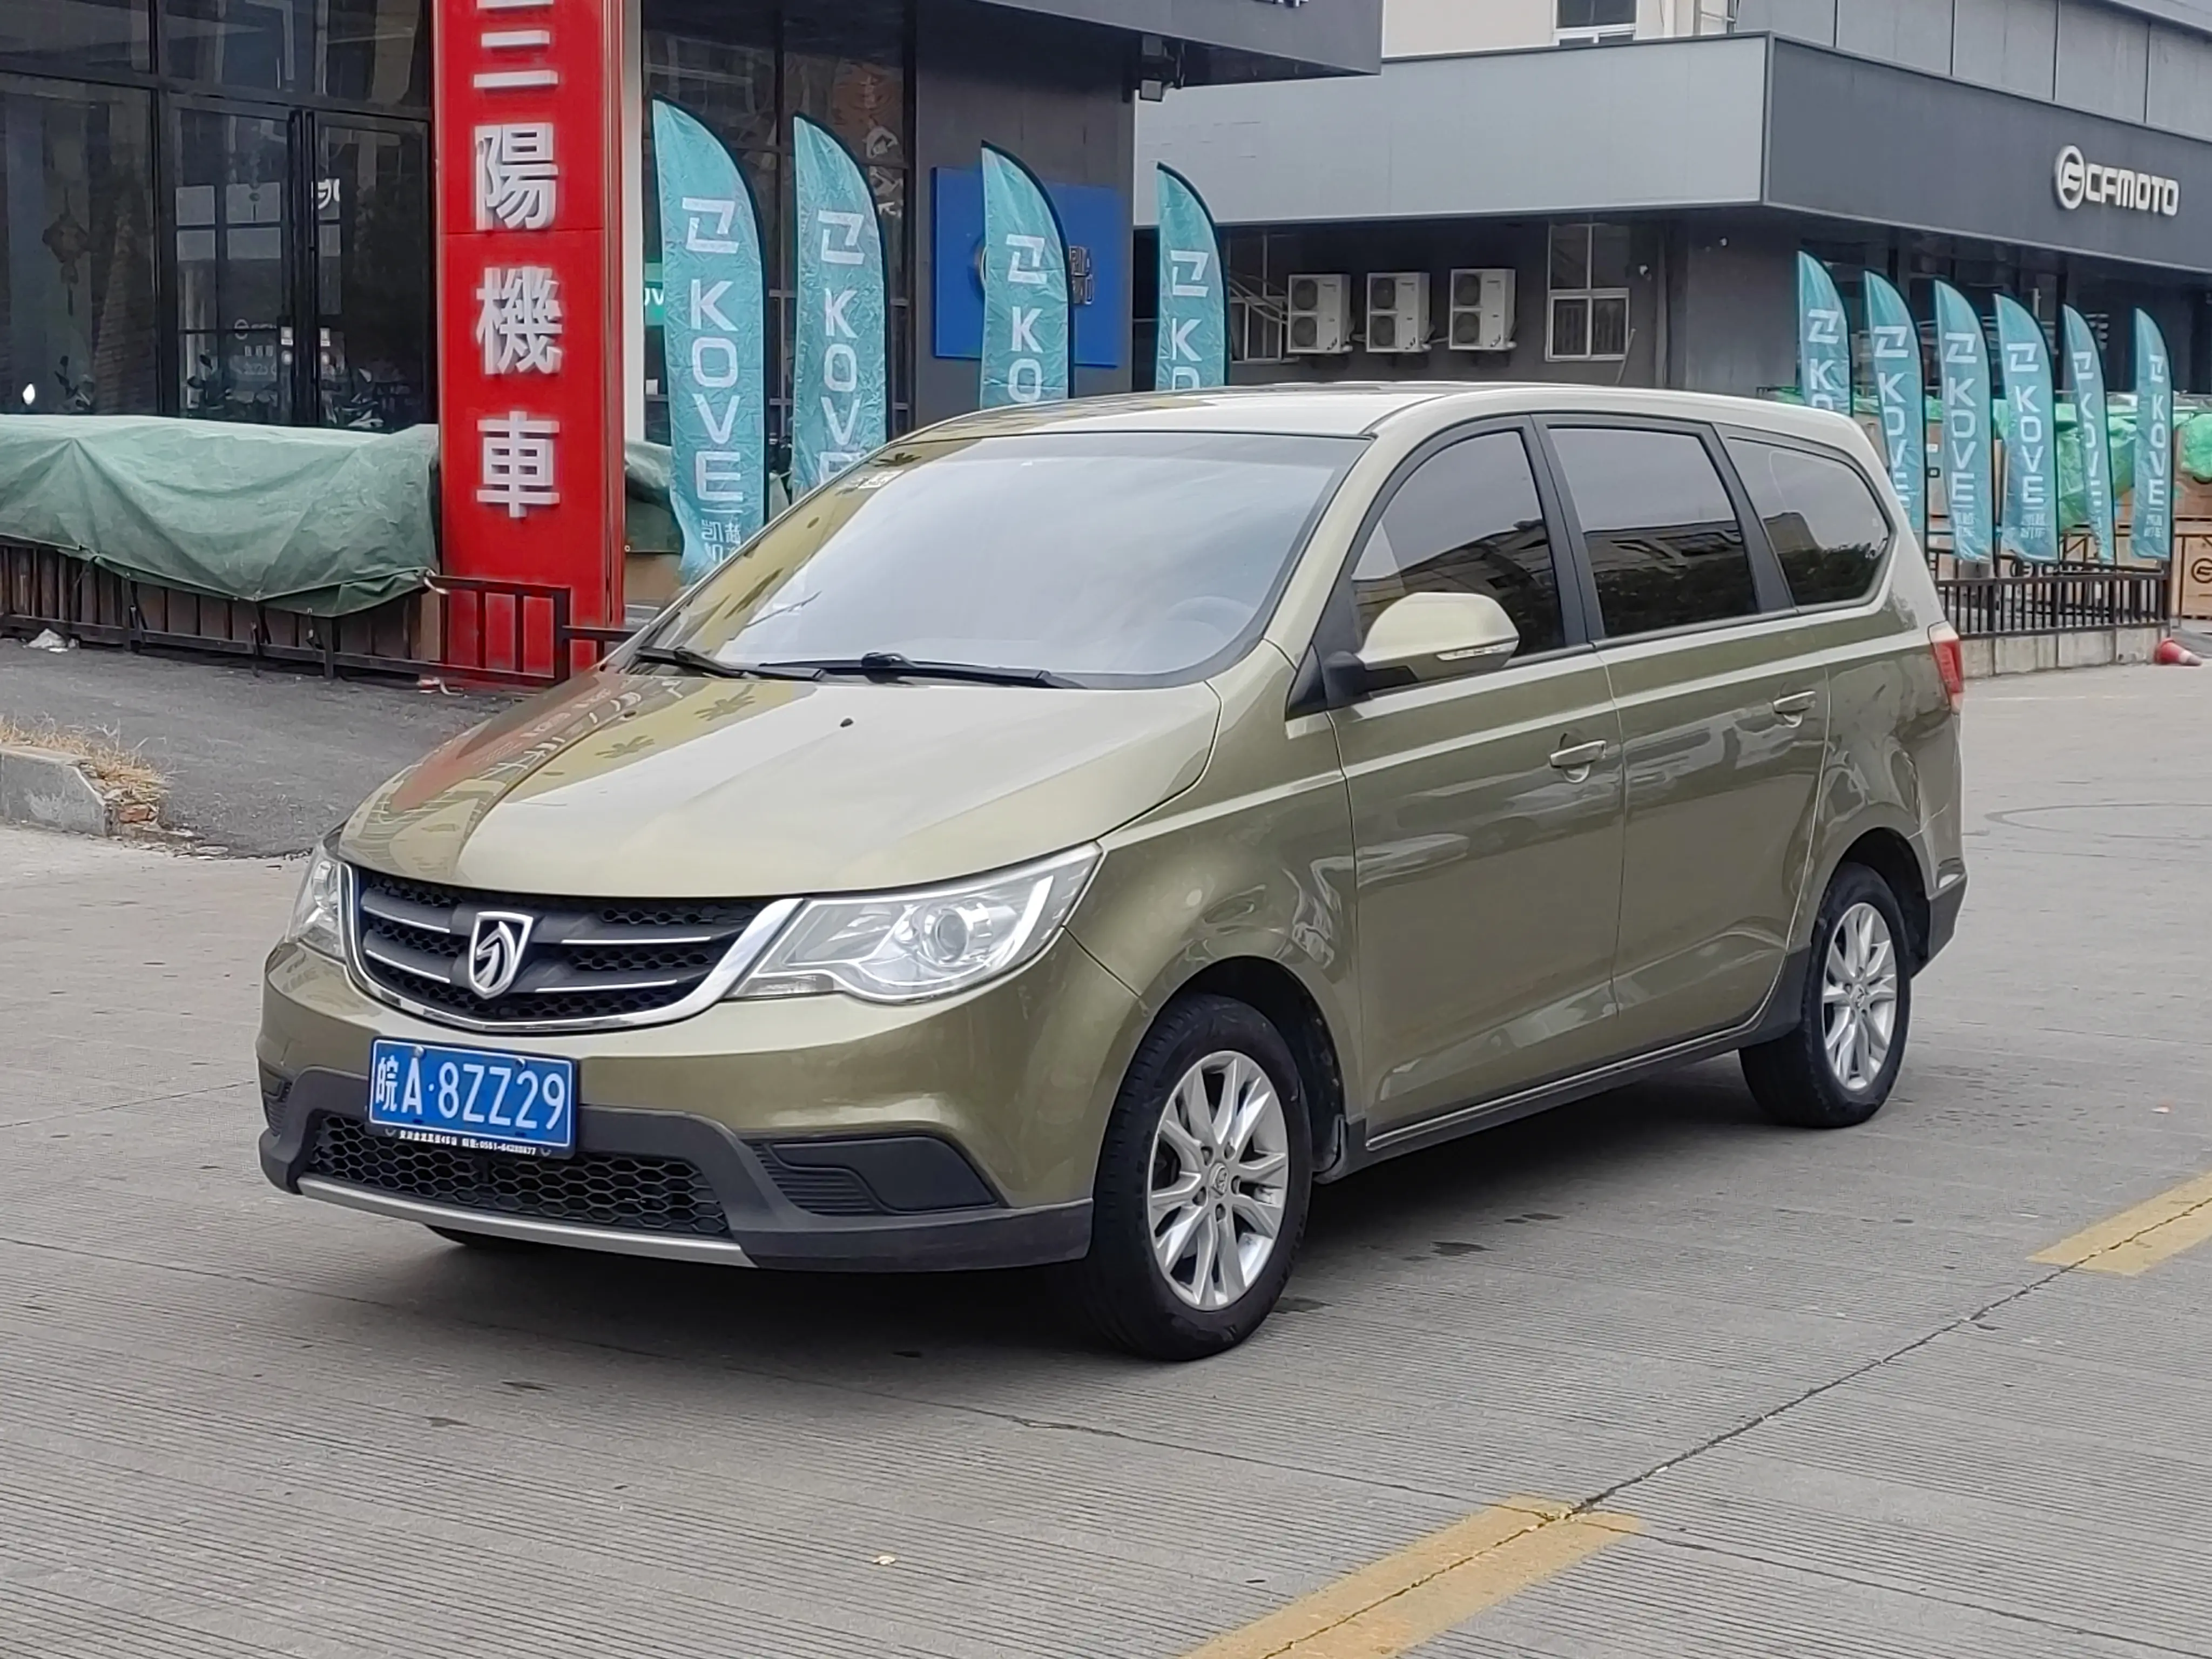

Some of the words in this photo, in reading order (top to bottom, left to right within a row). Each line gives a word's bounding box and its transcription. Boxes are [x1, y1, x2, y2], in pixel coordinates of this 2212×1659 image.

[2085, 163, 2180, 216] CFMOTO
[472, 0, 563, 518] 三陽機車
[690, 279, 744, 502] KOVE
[1948, 377, 1977, 501] KOVE
[2015, 385, 2044, 503] KOVE
[2149, 393, 2166, 505] KOVE
